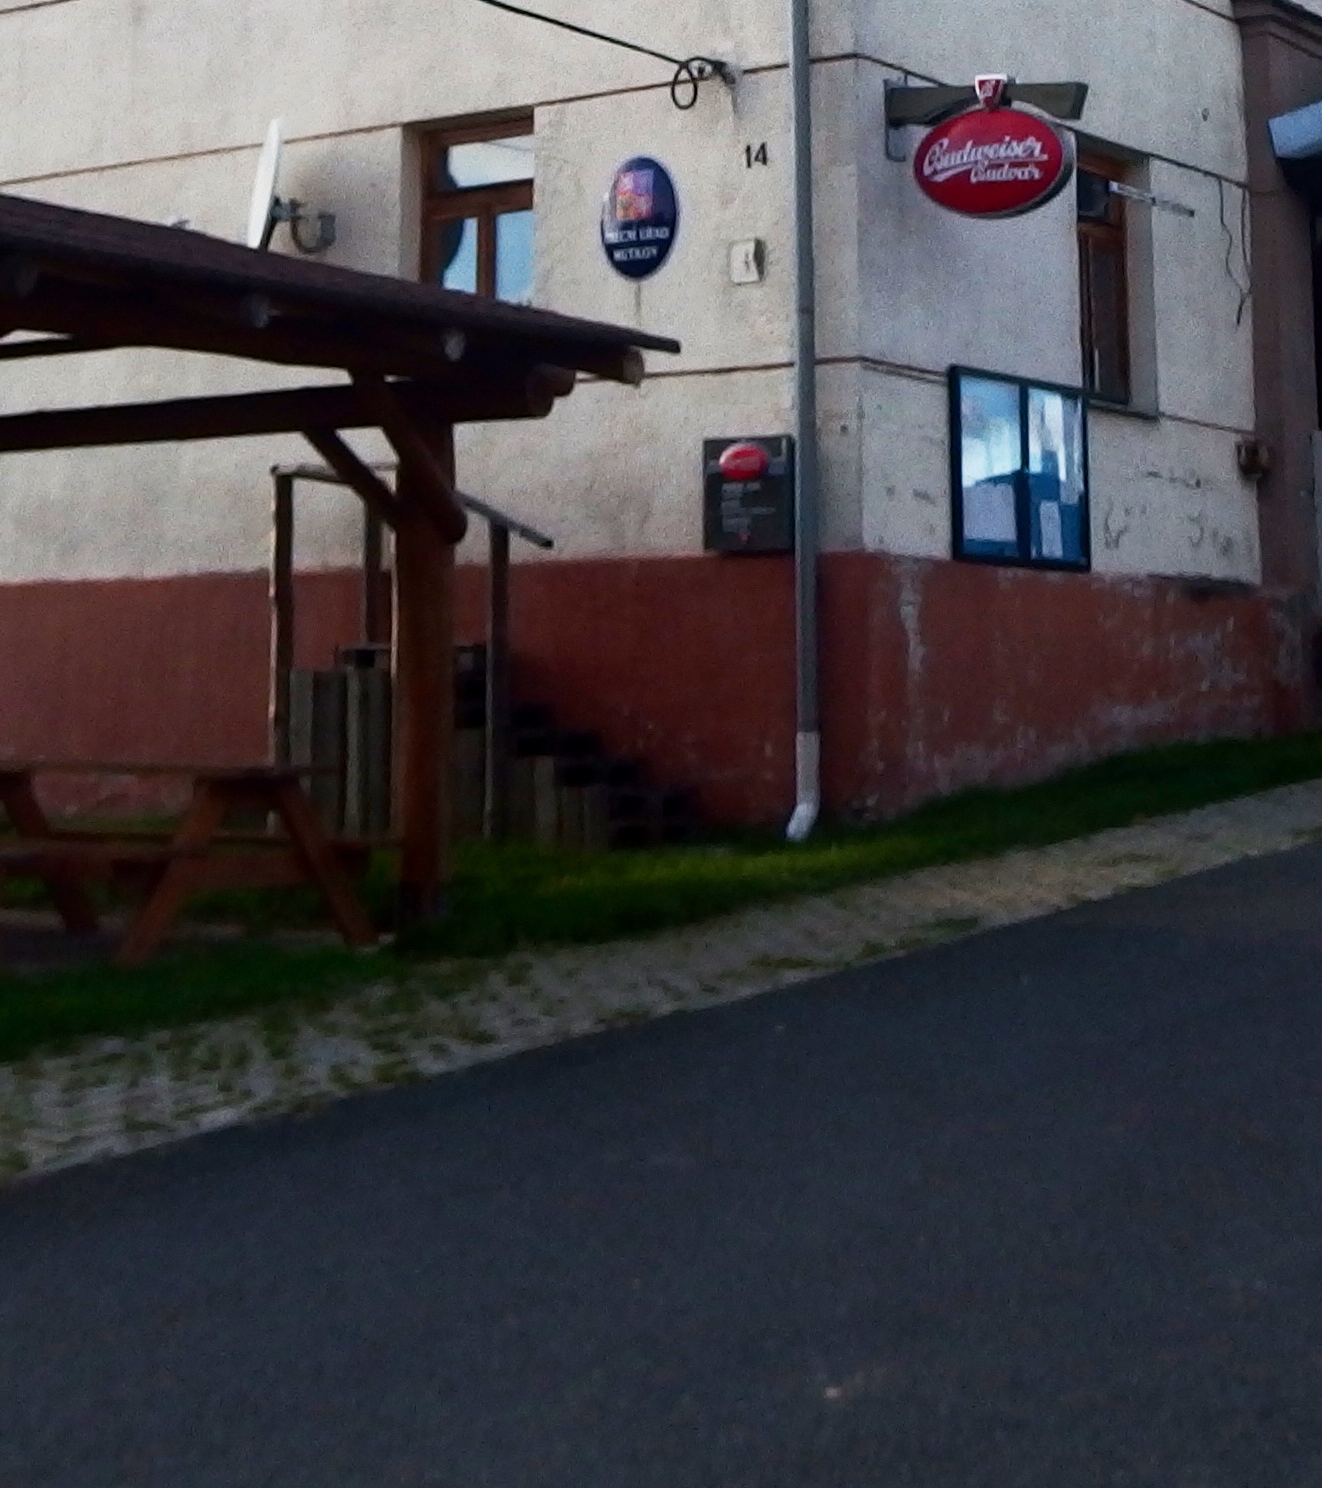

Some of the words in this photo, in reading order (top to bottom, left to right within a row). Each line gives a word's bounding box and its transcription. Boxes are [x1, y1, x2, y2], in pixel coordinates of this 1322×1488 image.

[745, 141, 768, 169] 14
[923, 135, 1049, 179] Budweiser
[604, 226, 637, 243] ECNÍ
